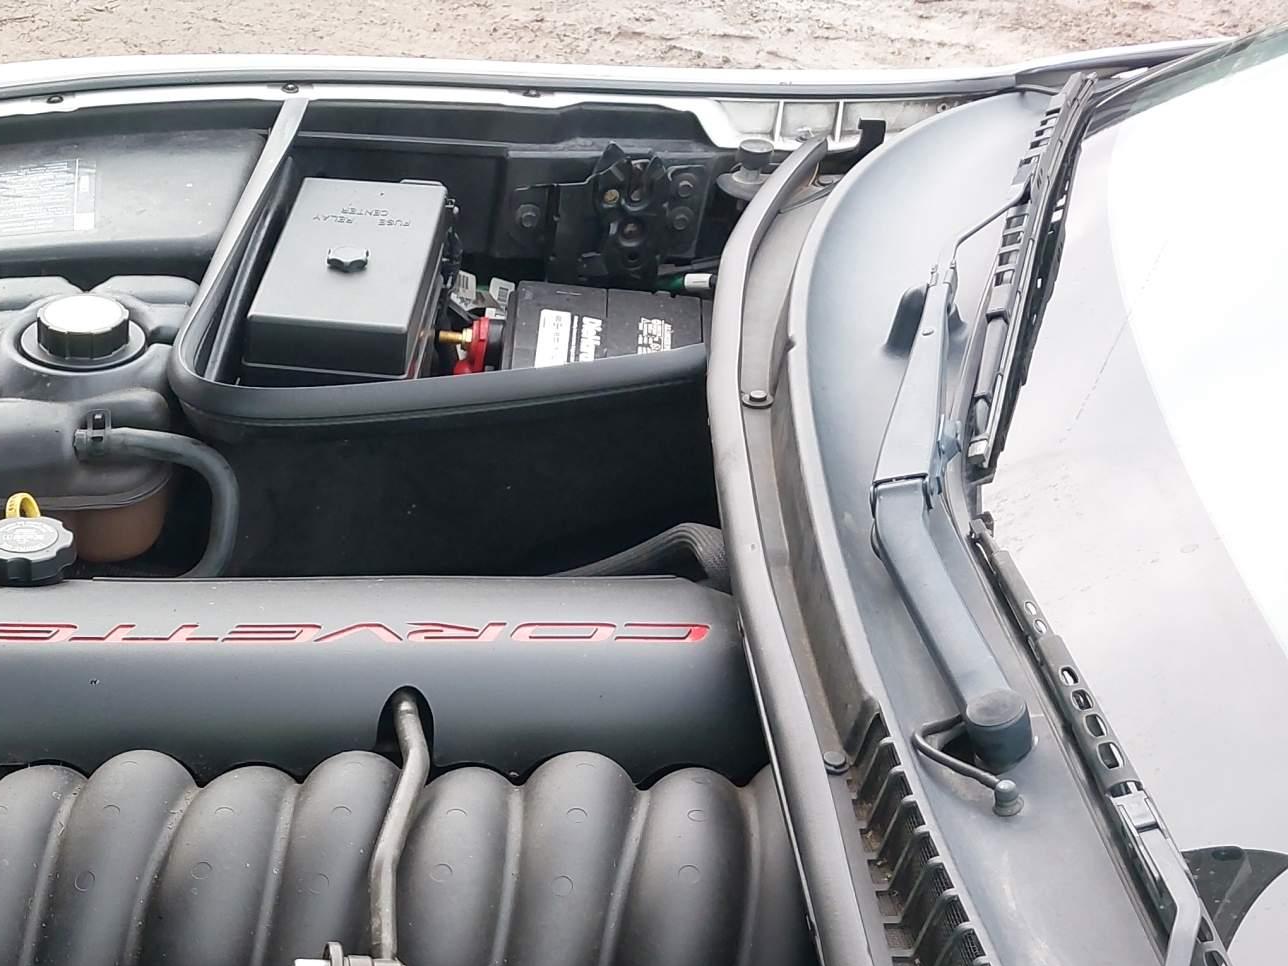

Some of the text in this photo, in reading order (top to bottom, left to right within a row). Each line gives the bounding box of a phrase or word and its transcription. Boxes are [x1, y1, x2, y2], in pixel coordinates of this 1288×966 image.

[341, 207, 389, 217] CENTER
[312, 215, 410, 227] FUSE RELAY
